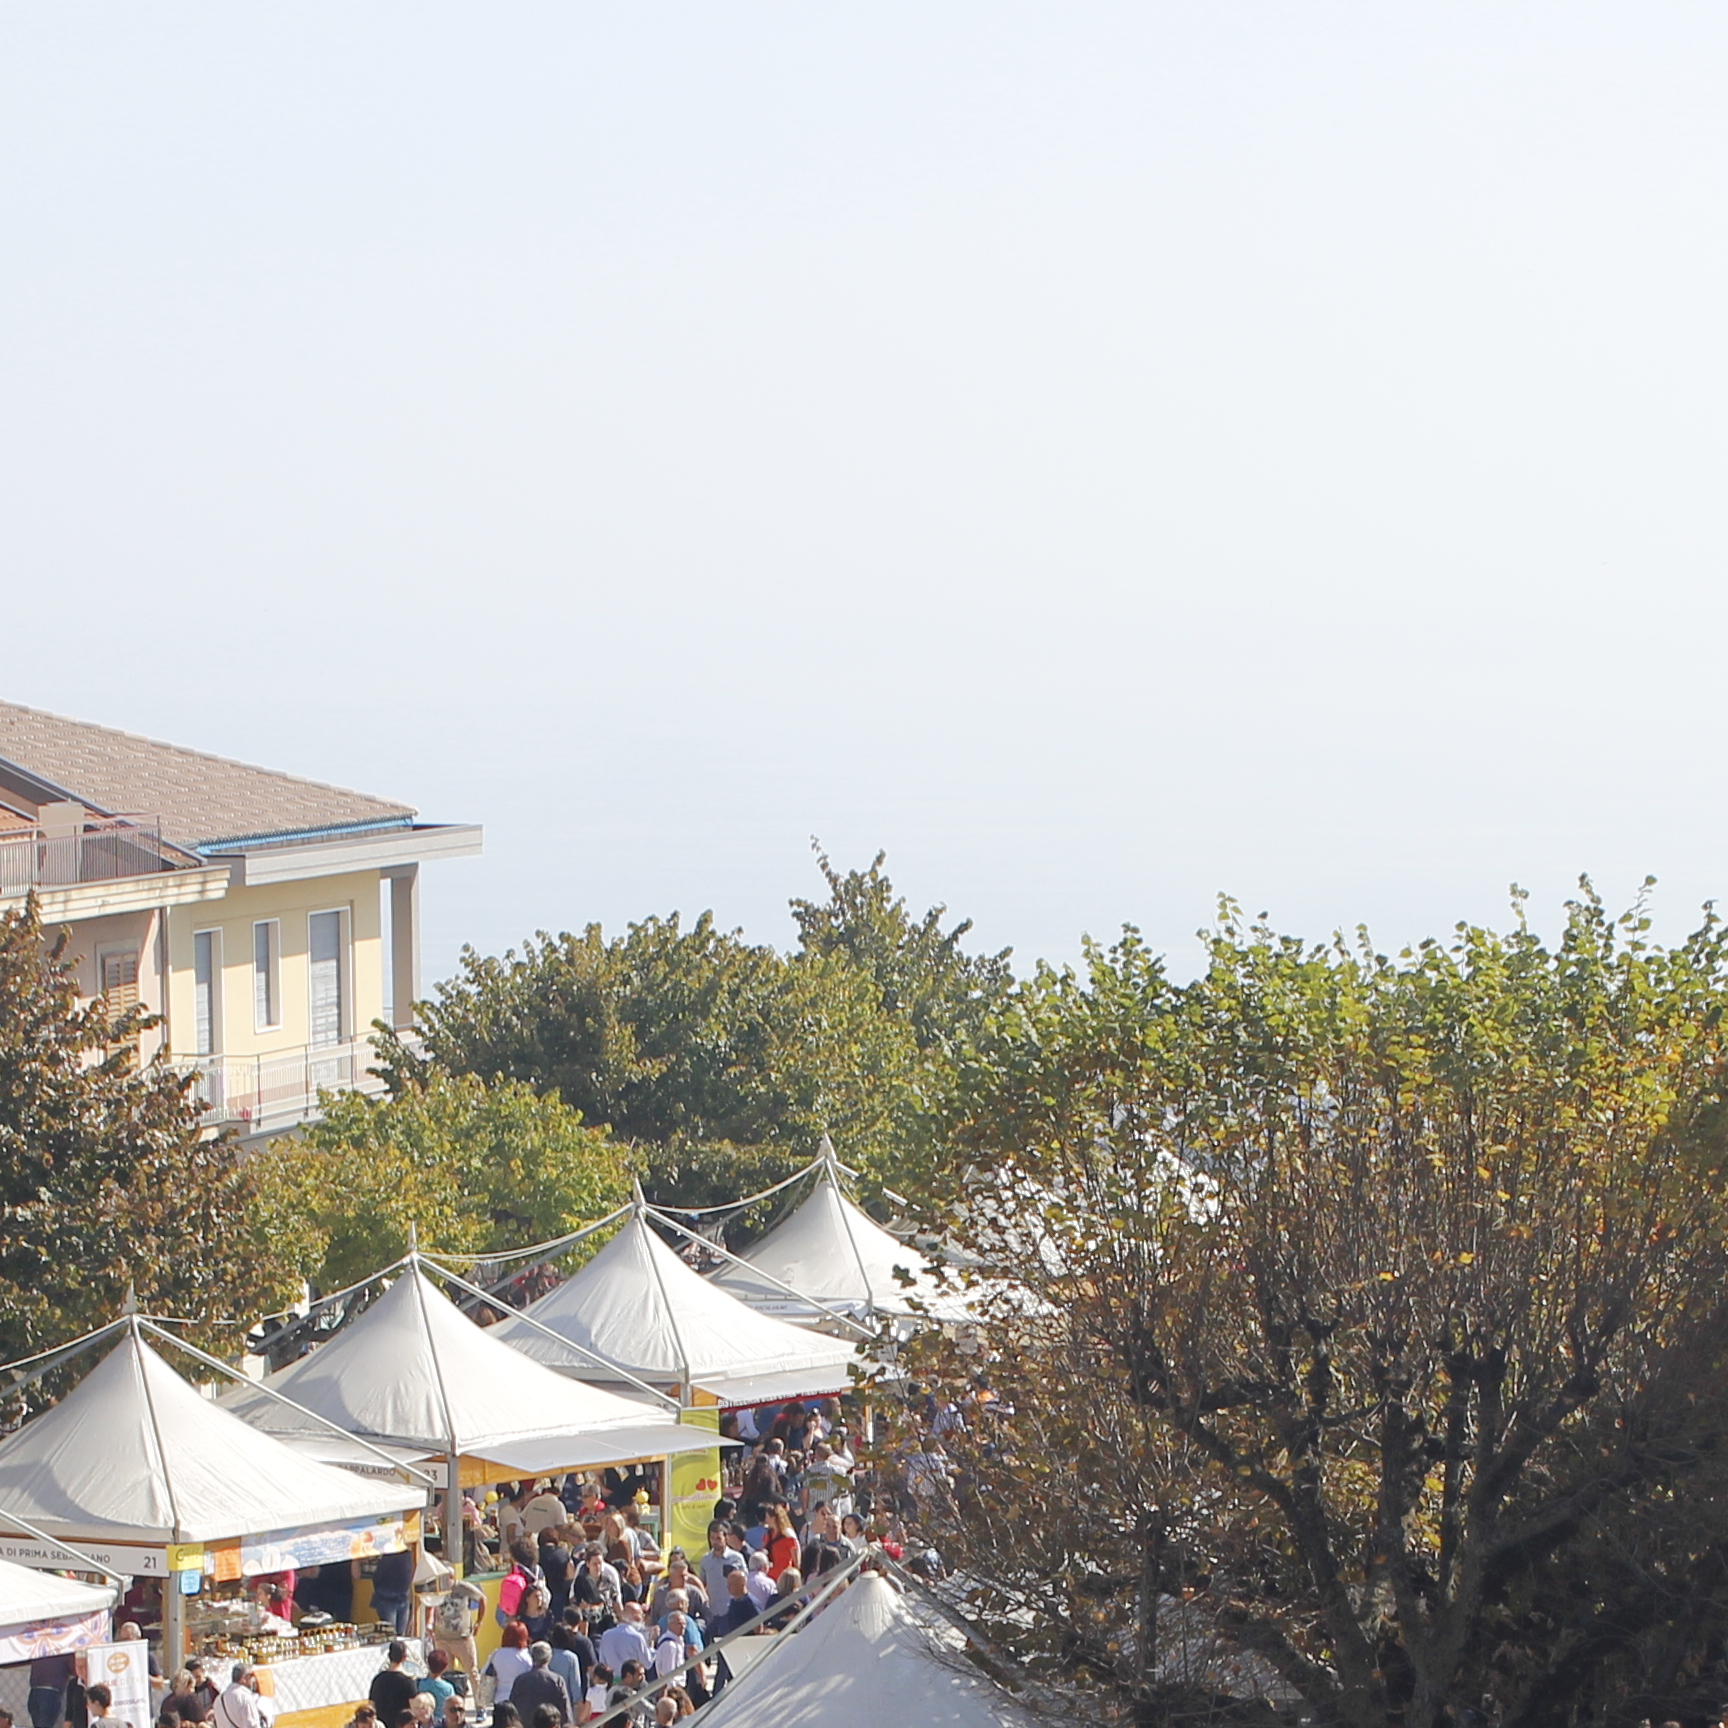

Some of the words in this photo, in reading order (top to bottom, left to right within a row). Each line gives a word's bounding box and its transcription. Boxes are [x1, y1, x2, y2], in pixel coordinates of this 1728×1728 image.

[6, 1546, 17, 1556] DI
[19, 1547, 48, 1559] PRIMA
[143, 1556, 157, 1569] 21
